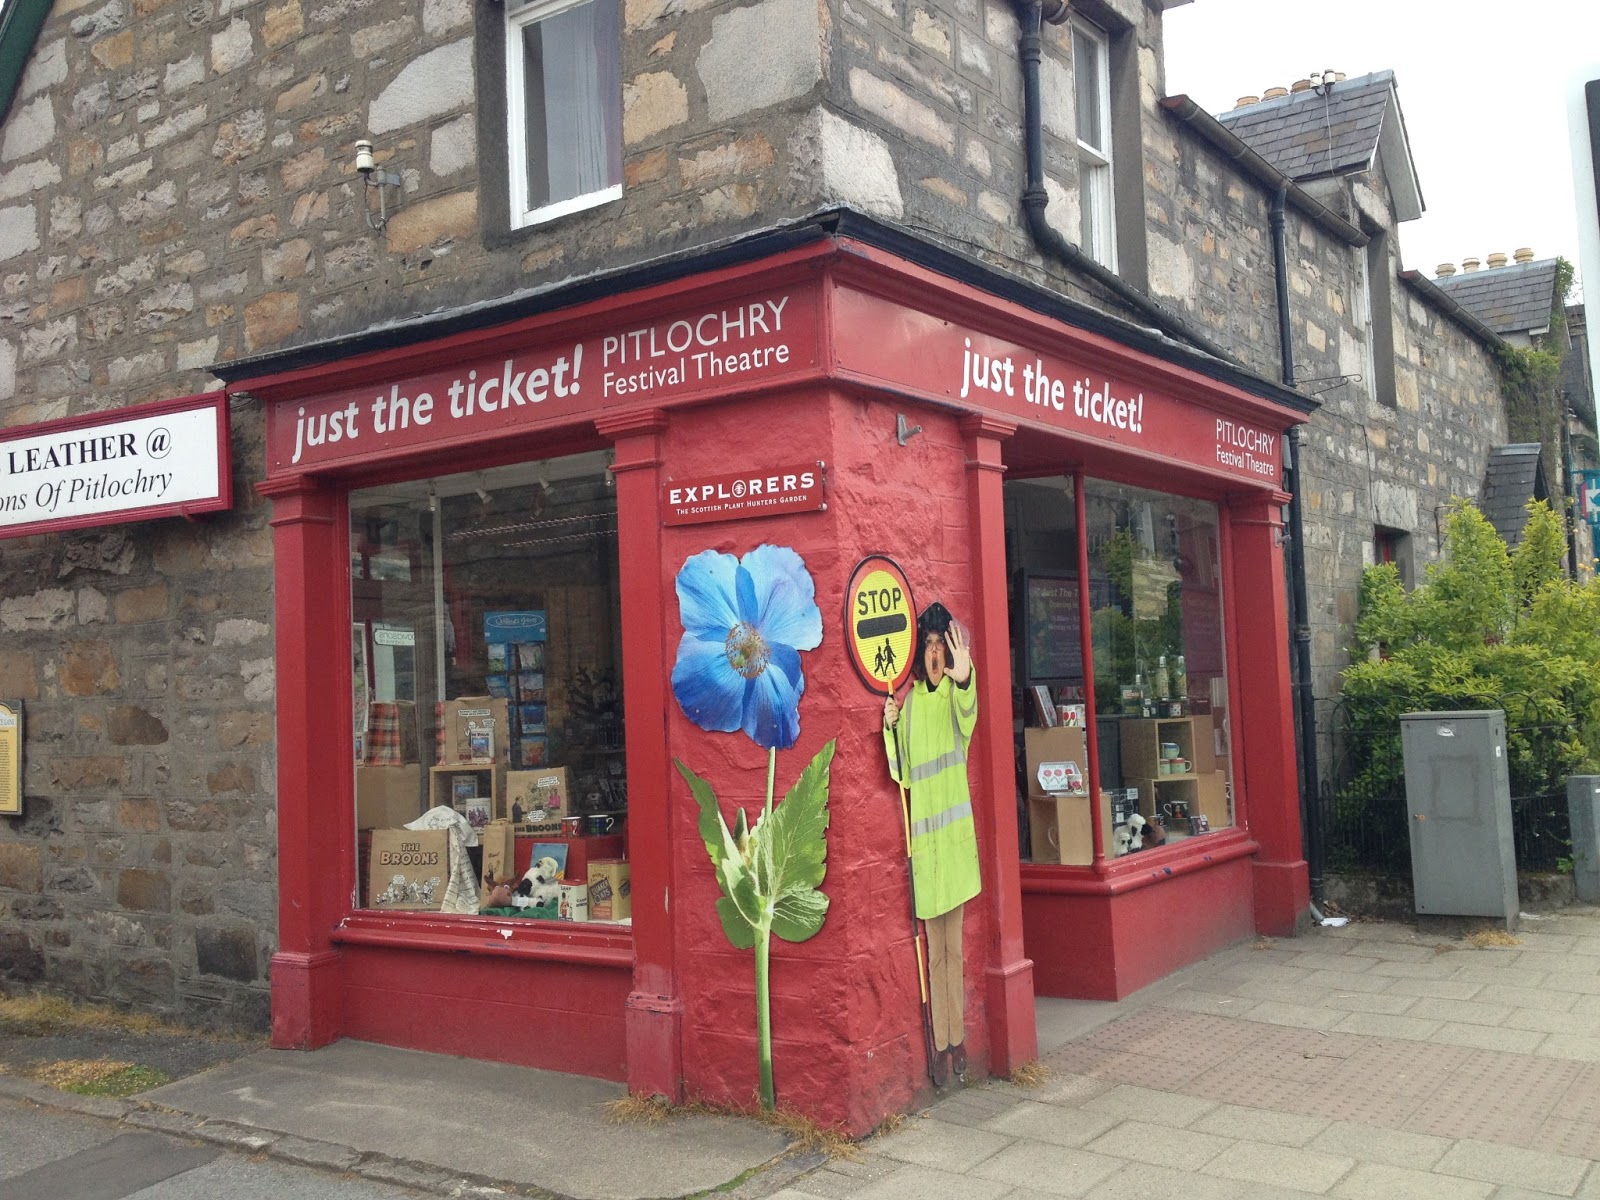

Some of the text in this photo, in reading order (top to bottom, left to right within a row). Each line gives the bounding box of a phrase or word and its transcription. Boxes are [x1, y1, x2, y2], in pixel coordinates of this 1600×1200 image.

[604, 296, 789, 367] PITLOCHRY
[603, 343, 789, 397] Festival Theatre
[961, 337, 1144, 434] just the ticket!
[291, 343, 584, 463] just the ticket!
[7, 427, 172, 475] LEATHER @
[1216, 418, 1275, 456] PITLOCHRY
[1216, 444, 1274, 476] Festival Theatre
[36, 479, 66, 513] Of
[67, 469, 172, 504] Pitlochry
[669, 472, 815, 504] EXPLORERS
[857, 587, 901, 616] STOP
[379, 850, 438, 865] BROONS
[401, 842, 420, 852] THE
